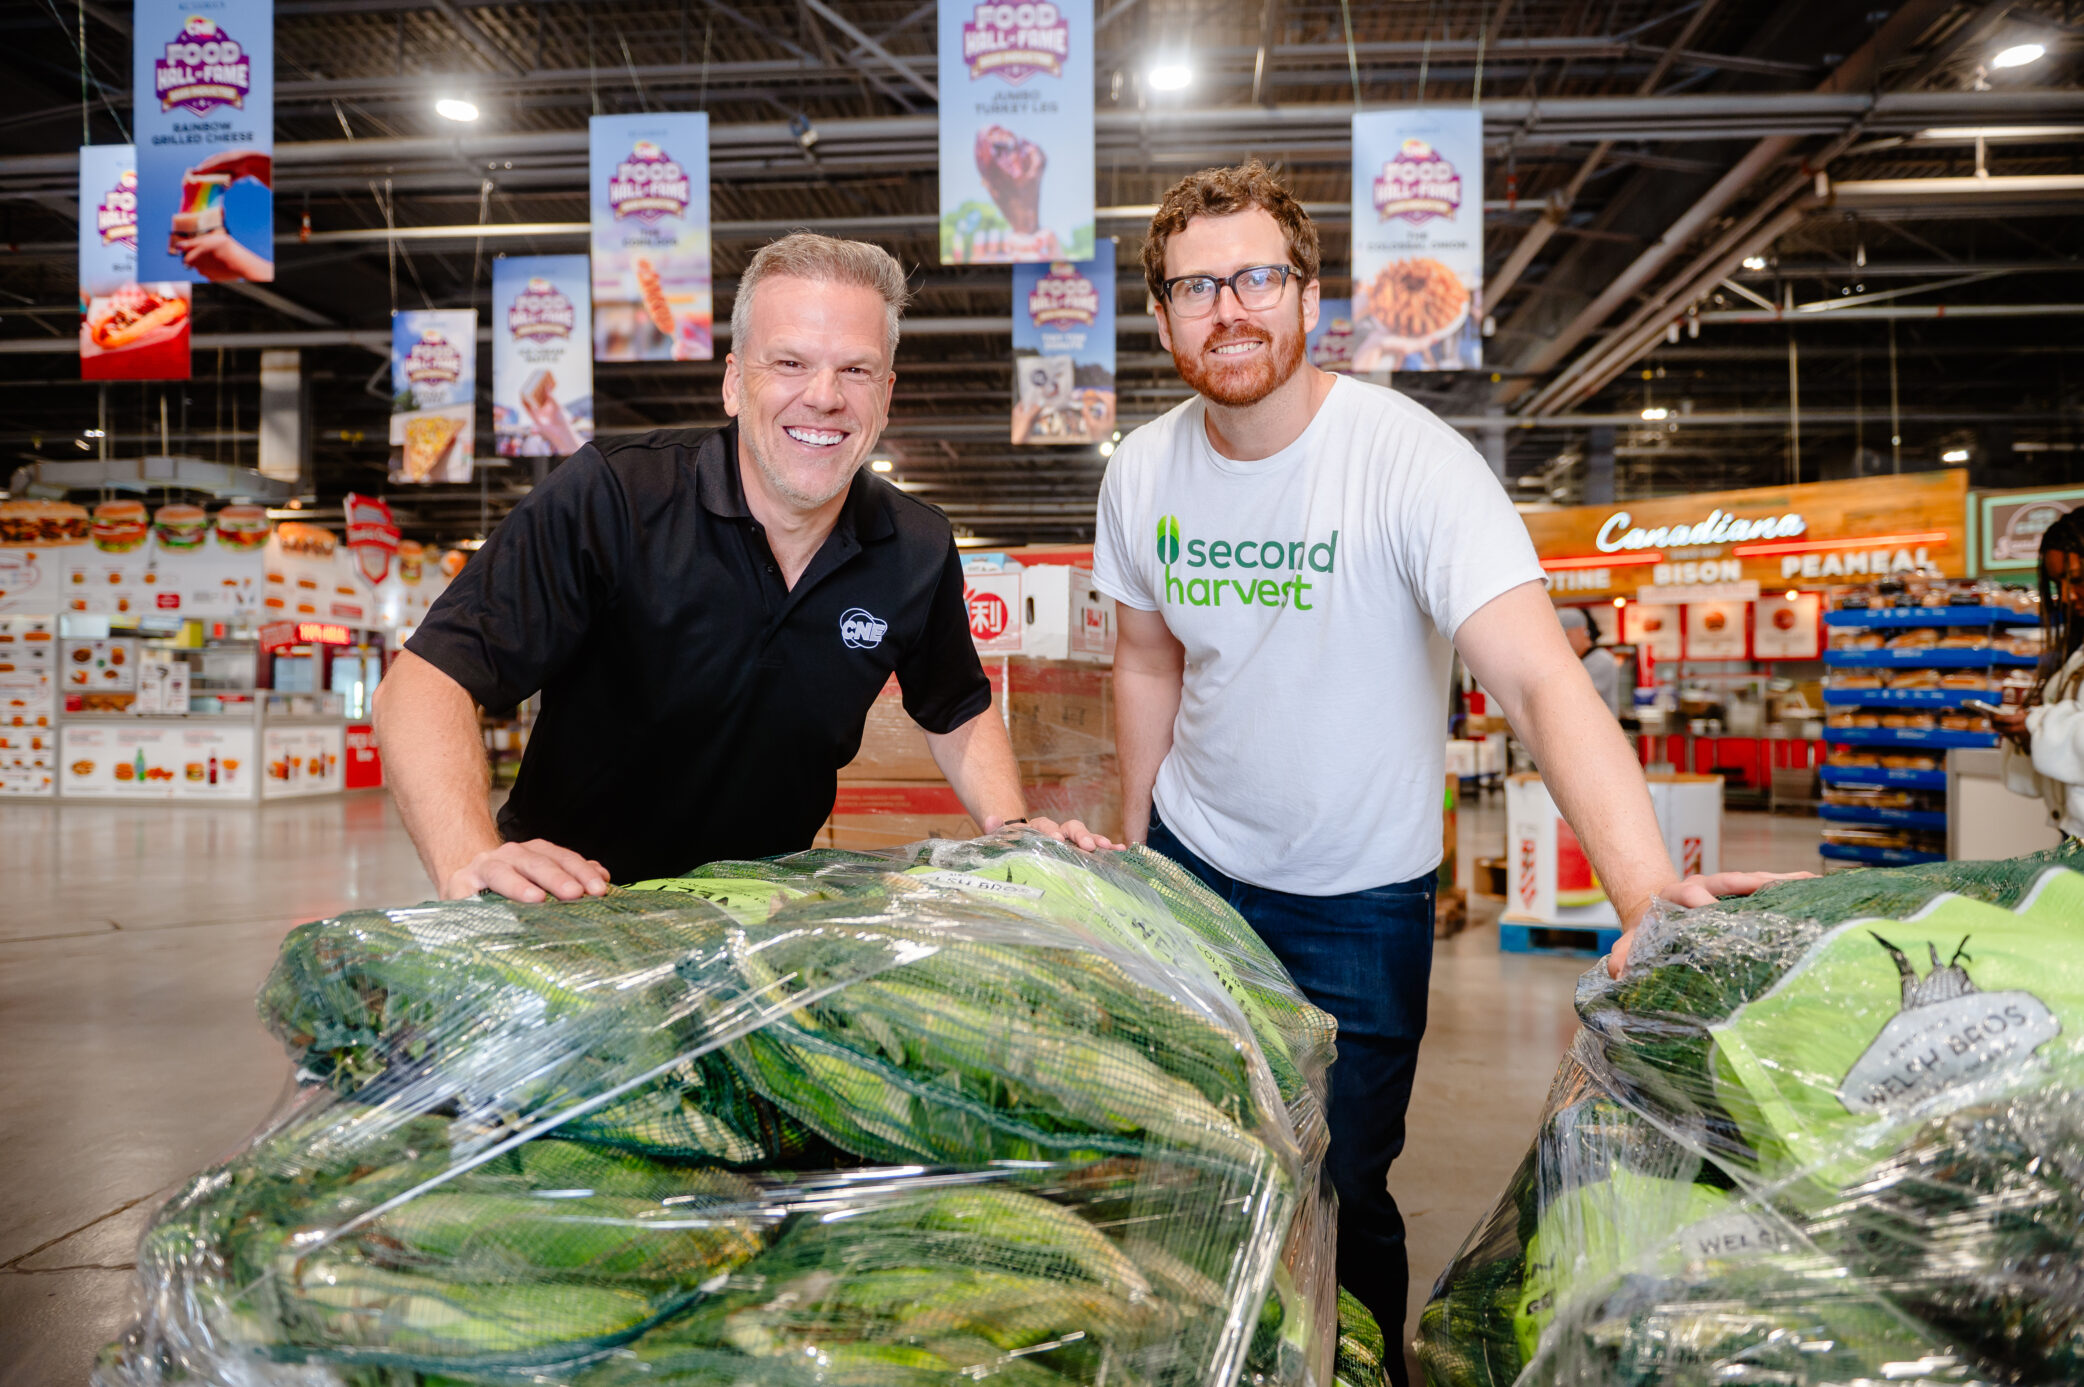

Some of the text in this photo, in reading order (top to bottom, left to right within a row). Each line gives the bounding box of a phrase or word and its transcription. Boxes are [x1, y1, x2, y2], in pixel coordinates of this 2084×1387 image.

[976, 3, 1059, 31] FOOD
[166, 41, 241, 67] FOOD
[975, 103, 1029, 115] TURKEY
[152, 133, 254, 146] GRILLED CHEESE
[172, 122, 231, 133] RAINBOW
[618, 163, 681, 184] FOOD
[1383, 162, 1453, 184] FOOD
[1037, 280, 1093, 296] FOOD
[1596, 508, 1806, 553] Canadiana
[1187, 530, 1339, 574] second
[1781, 549, 1938, 579] PEAMEAL
[1653, 559, 1742, 587] BISON
[1165, 564, 1313, 611] harvest
[971, 600, 1003, 633] 利
[841, 619, 886, 642] CNE
[1948, 1004, 2028, 1057] BROS
